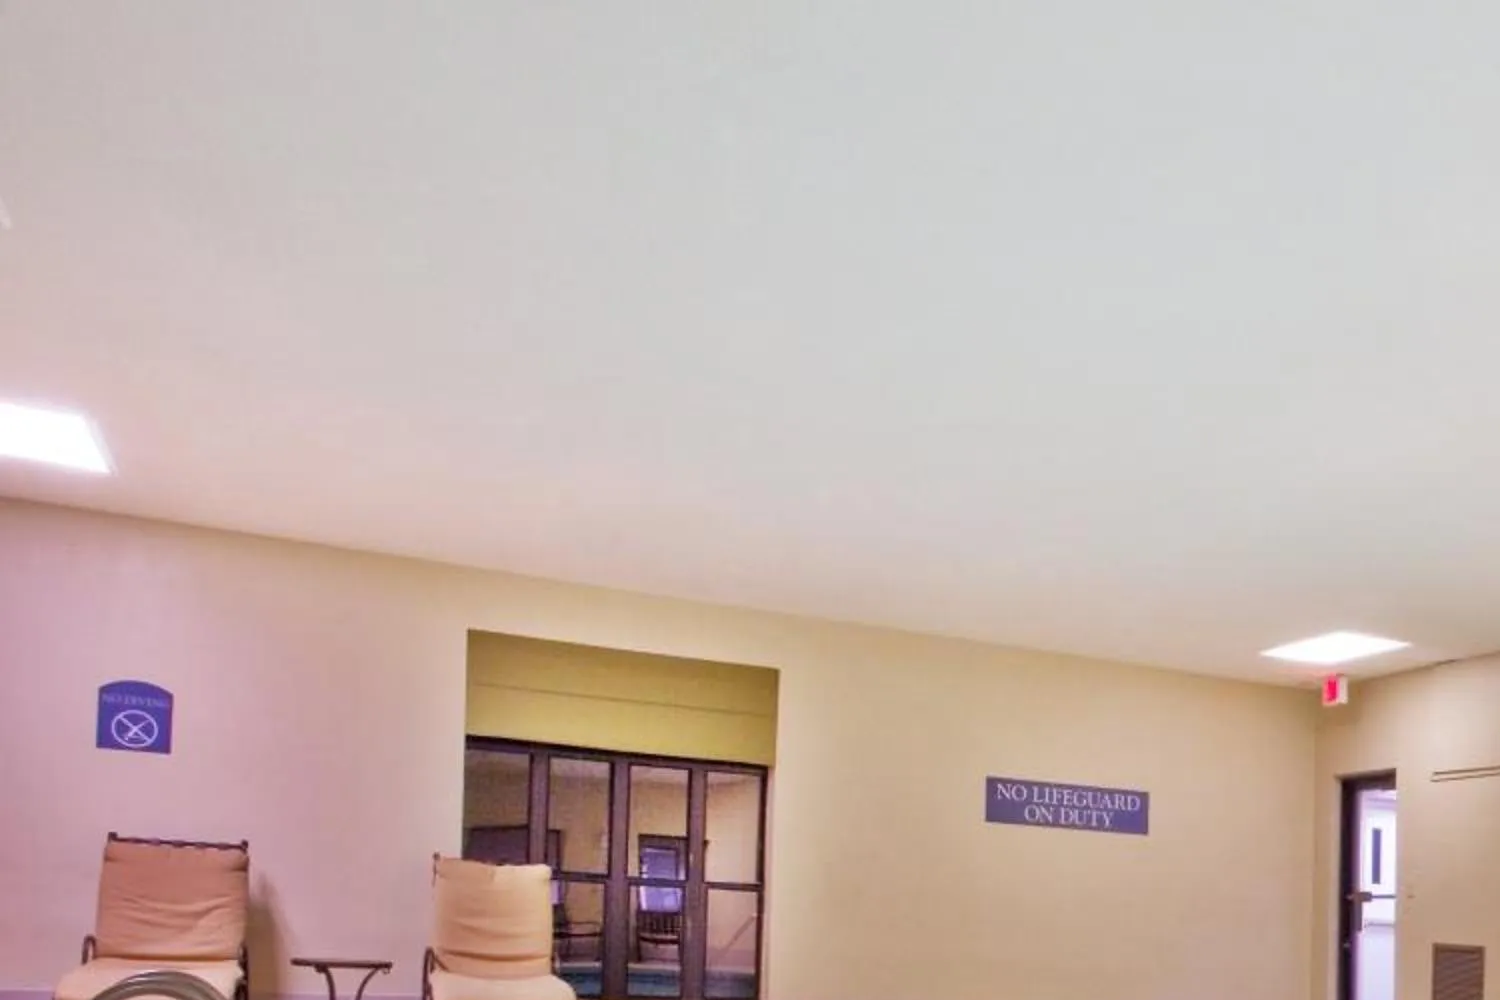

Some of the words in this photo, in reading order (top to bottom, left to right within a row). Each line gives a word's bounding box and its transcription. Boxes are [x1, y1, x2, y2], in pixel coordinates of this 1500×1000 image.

[996, 782, 1028, 801] NO
[1032, 786, 1141, 812] LIFEGUARD
[1024, 804, 1055, 823] ON
[1059, 807, 1114, 828] DUTY
